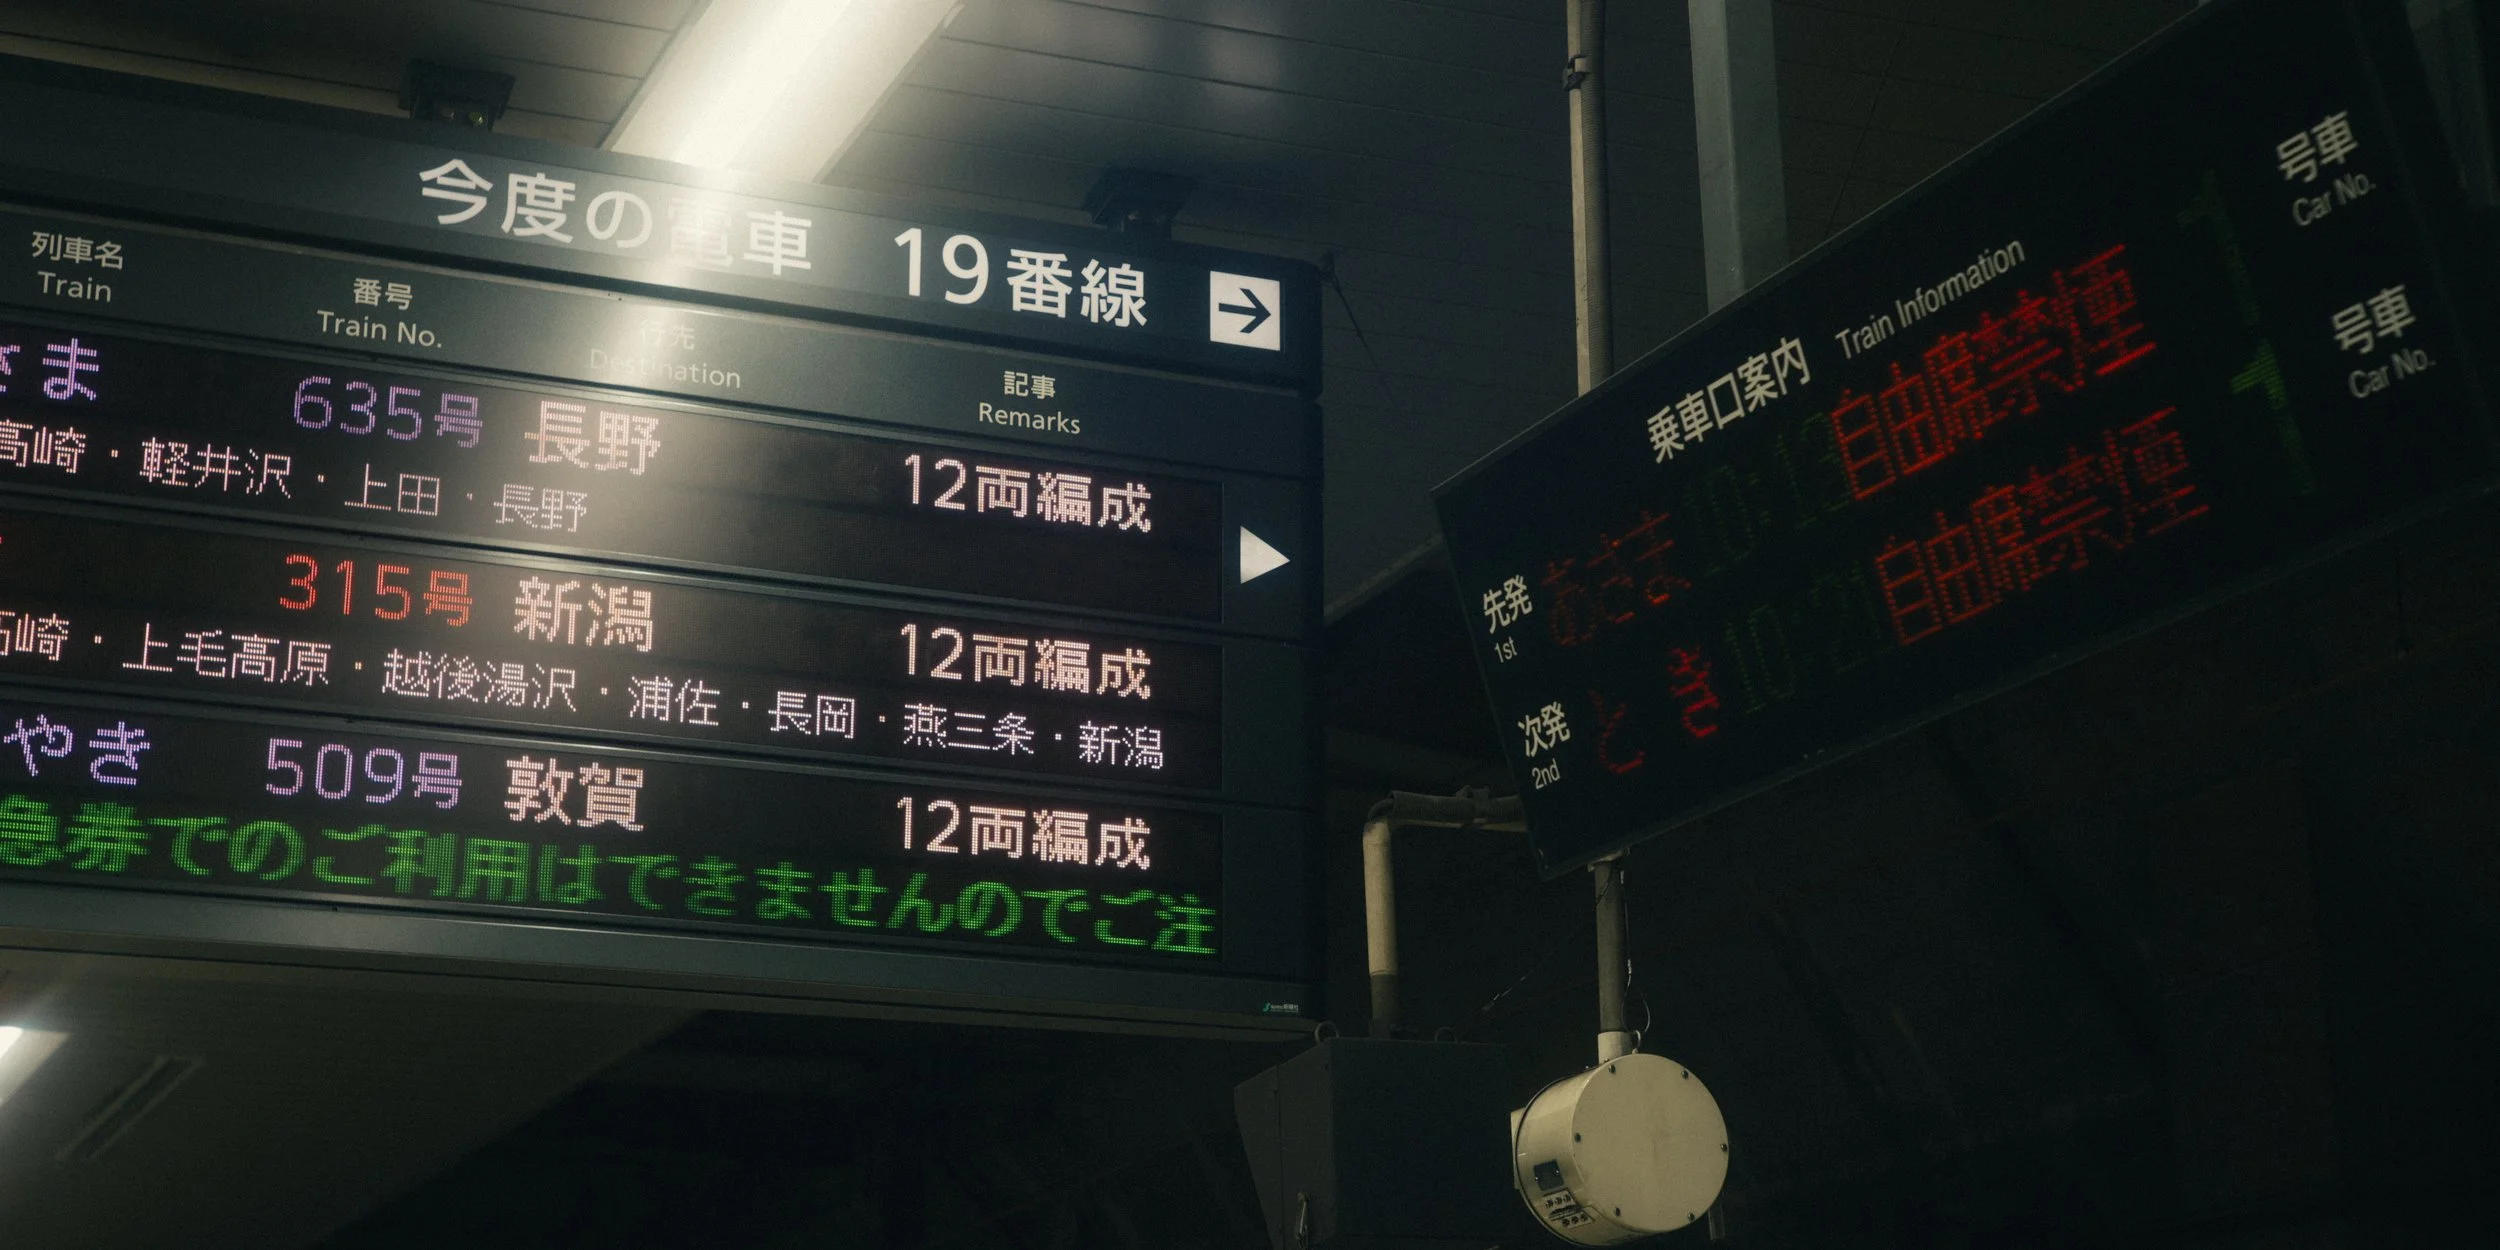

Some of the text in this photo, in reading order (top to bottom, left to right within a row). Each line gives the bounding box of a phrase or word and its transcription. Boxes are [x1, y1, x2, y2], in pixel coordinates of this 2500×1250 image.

[2276, 109, 2360, 184] 号車
[2292, 171, 2377, 227] Car No.
[31, 232, 124, 269] 列車名
[420, 158, 1148, 328] 今度の電車 19番線
[37, 272, 113, 303] Train
[352, 277, 414, 310] 番号
[1834, 239, 2026, 360] Train Information
[317, 310, 443, 349] Train No.
[640, 318, 695, 350] 行先
[2330, 283, 2417, 355] 号車
[589, 349, 741, 388] Destination
[1003, 370, 1056, 399] 記事
[2348, 348, 2437, 399] Car No.
[978, 402, 1082, 435] Remarks
[1646, 337, 1812, 464] 乗車口案内
[294, 375, 483, 448] 635号
[525, 399, 661, 475] 長野
[905, 454, 1152, 533] 12両編成
[1540, 510, 1693, 647] あさま
[1831, 242, 2159, 501] 自由席禁煙
[1875, 405, 2211, 648] 自由席禁煙
[280, 554, 1152, 699] 315号 新潟 12両編成
[1481, 573, 1533, 635] 先発
[1493, 639, 1519, 664] 1st
[1516, 701, 1572, 758] 次発
[3, 714, 1151, 870] やき 509号 敦賀 12両編成
[1530, 763, 1562, 790] 2nd
